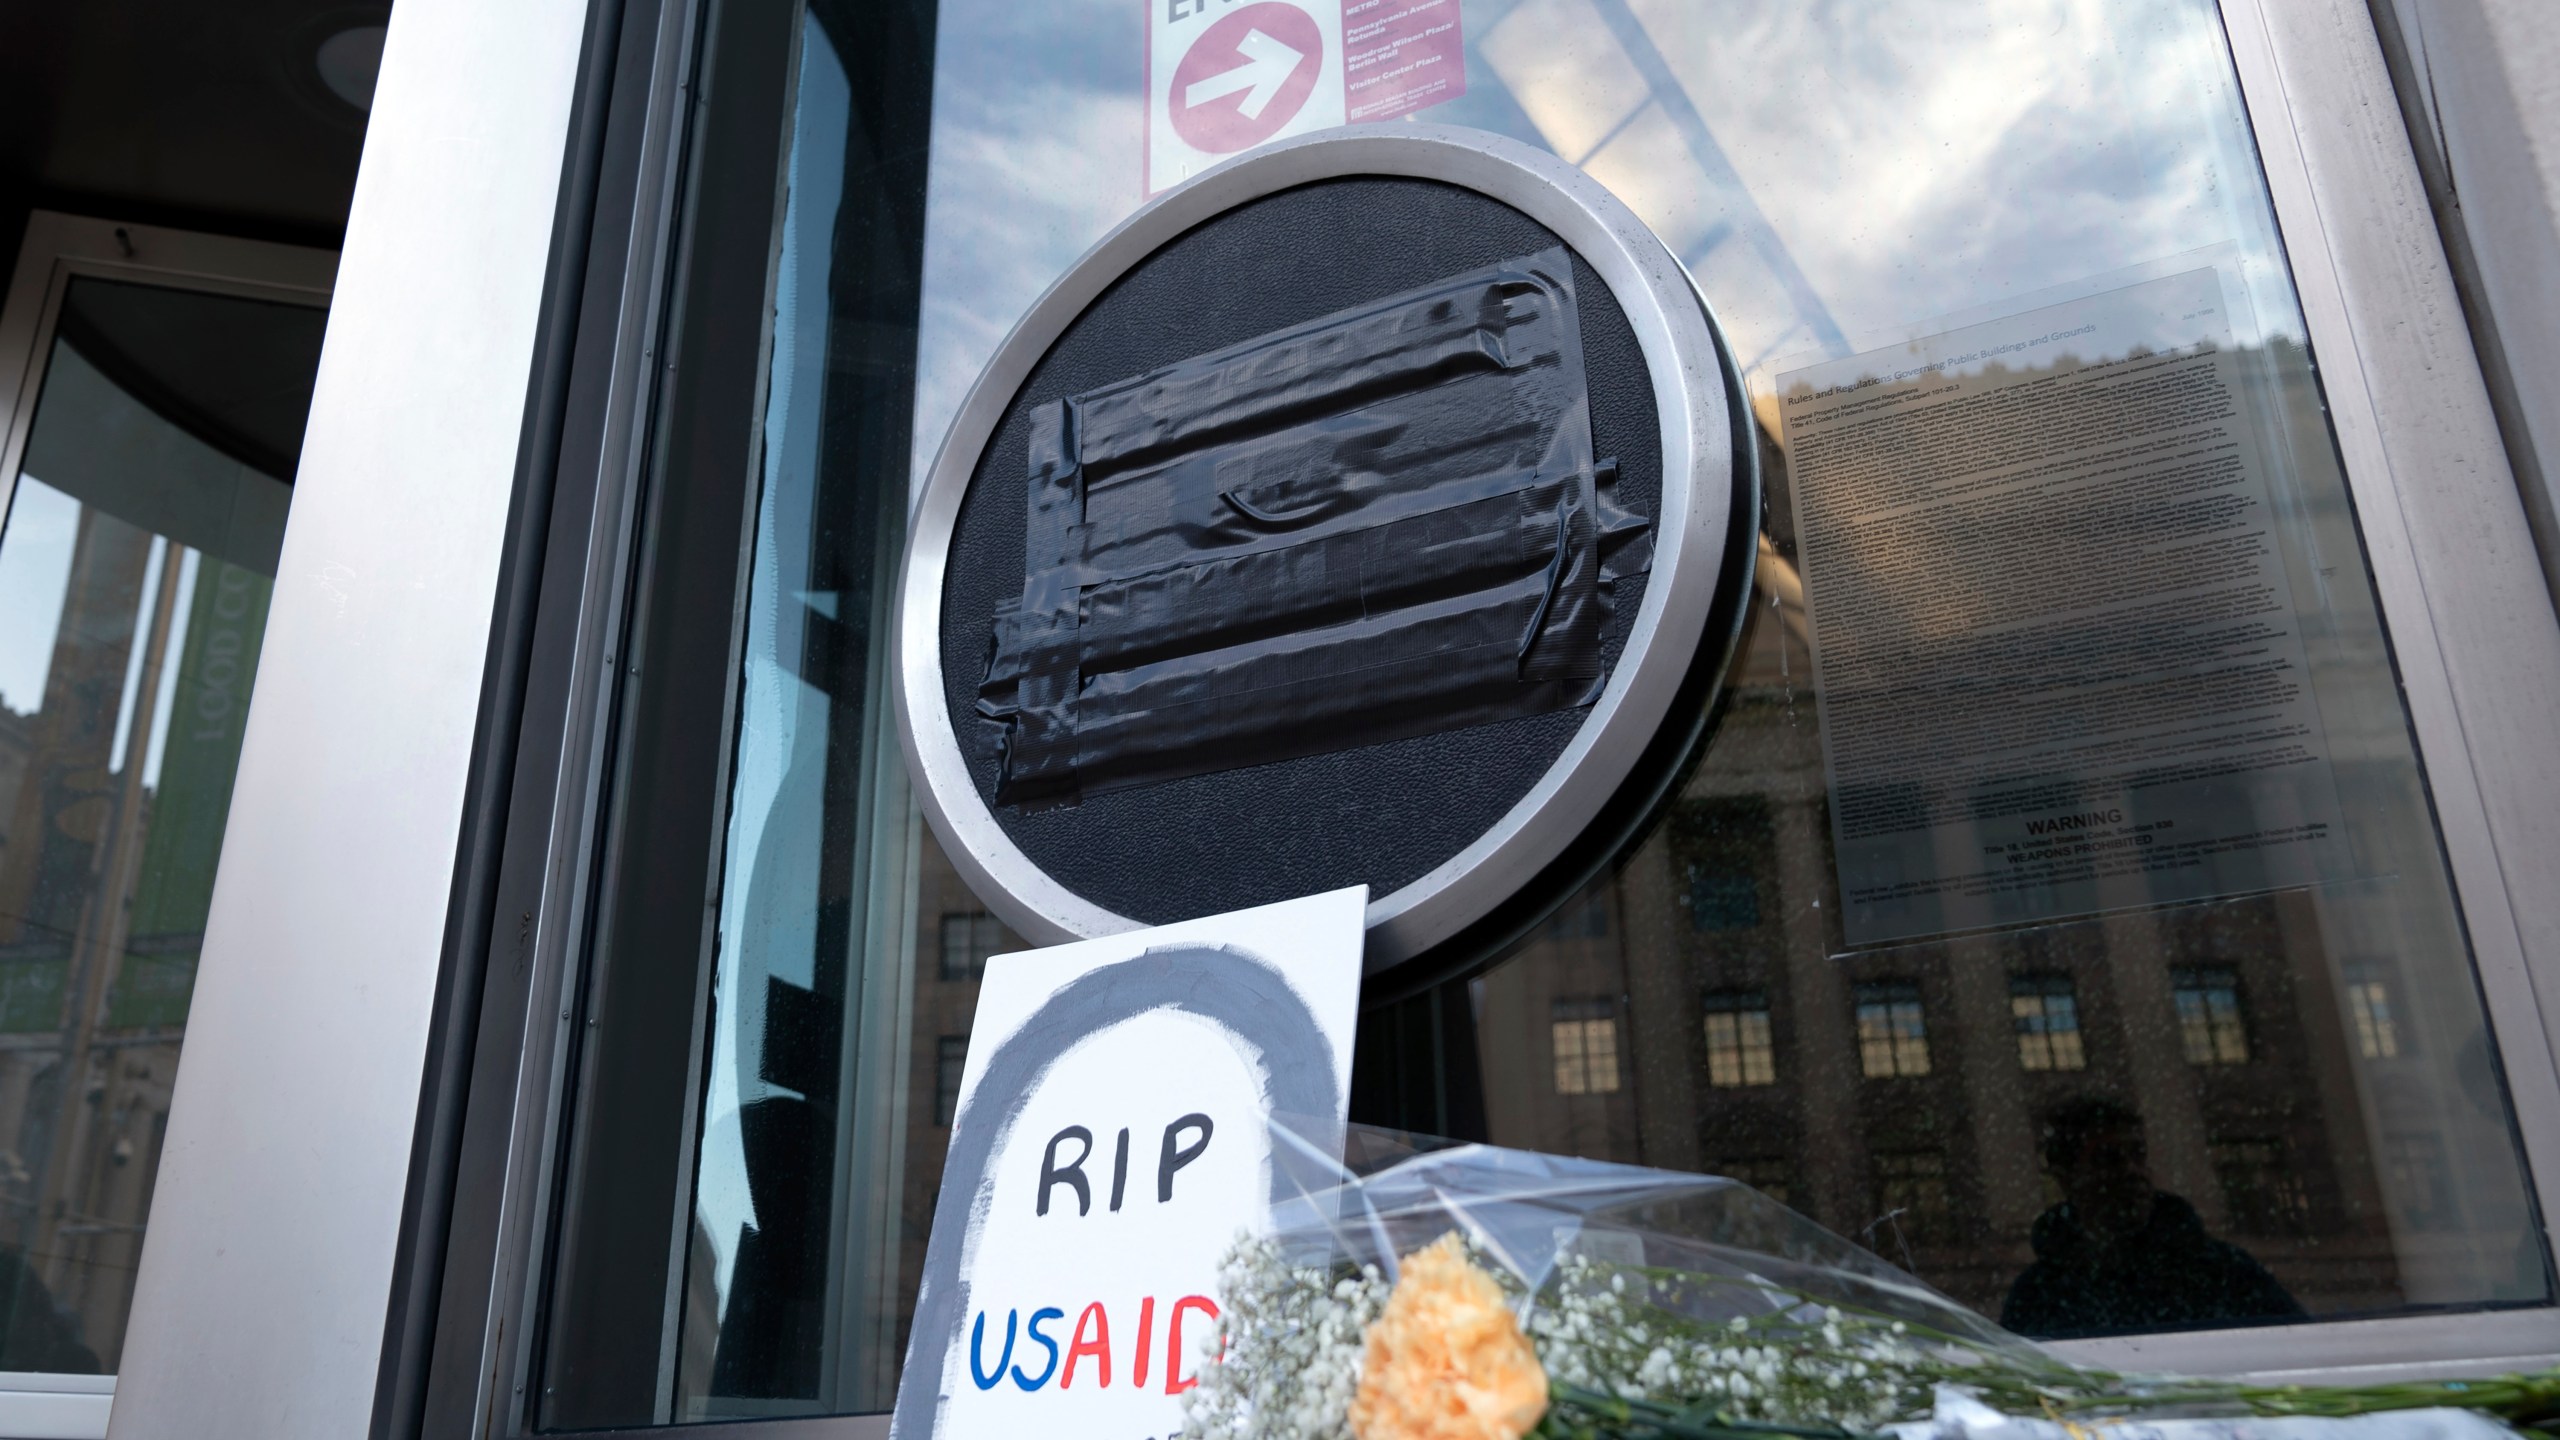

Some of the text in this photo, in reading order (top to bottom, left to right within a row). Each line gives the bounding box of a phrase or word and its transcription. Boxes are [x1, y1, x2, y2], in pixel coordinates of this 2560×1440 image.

[1346, 0, 1380, 16] METRO
[1347, 10, 1409, 36] Pennsylvania
[1347, 26, 1386, 44] Rotunda
[1348, 20, 1455, 64] Woodrow Wilson Plaza/
[1348, 48, 1398, 72] Berlin Wall
[1348, 53, 1442, 91] Visitor Center Plaza
[1433, 78, 1447, 88] AND
[1787, 322, 2097, 406] Rules and Regulations Governing Public Buildings and Grounds
[1789, 387, 1918, 423] Federal Property Management Regulations
[1790, 421, 1804, 429] Title
[1815, 414, 1832, 423] Code
[1840, 406, 1864, 417] Federal
[1904, 391, 1930, 402] Subpart
[1931, 383, 1960, 396] 101-20.3
[1983, 844, 2004, 855] Title
[2021, 836, 2053, 849] United
[2054, 831, 2084, 844] States
[2085, 827, 2115, 840] Code,
[2116, 821, 2154, 835] Section
[2025, 807, 2122, 836] WARNING
[2006, 833, 2154, 864] WEAPONS PROHIBITED
[1036, 1112, 1214, 1217] RIP
[970, 1294, 1228, 1396] USAID
